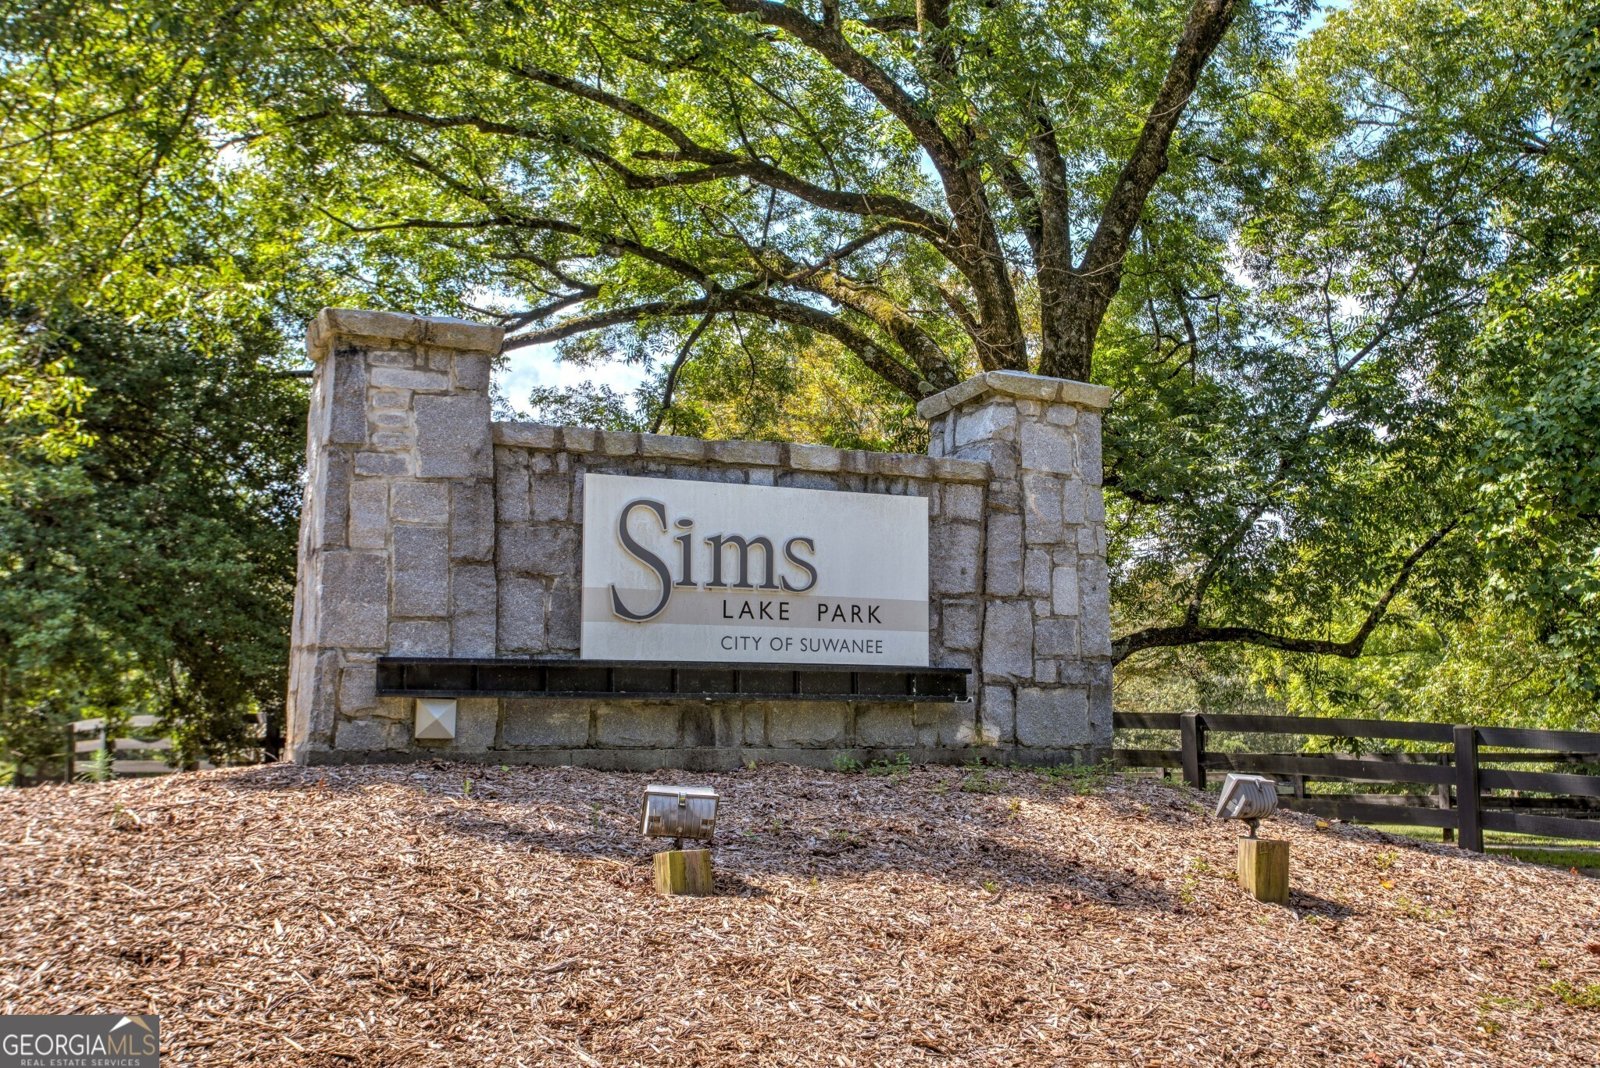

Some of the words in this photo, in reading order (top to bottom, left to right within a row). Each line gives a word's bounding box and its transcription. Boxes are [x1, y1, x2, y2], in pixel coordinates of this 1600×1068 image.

[608, 498, 819, 623] Sims
[722, 599, 791, 621] LAKE
[817, 603, 883, 625] PARK
[720, 635, 763, 652] CITY
[769, 636, 793, 652] OF
[800, 637, 884, 655] SUWANEE
